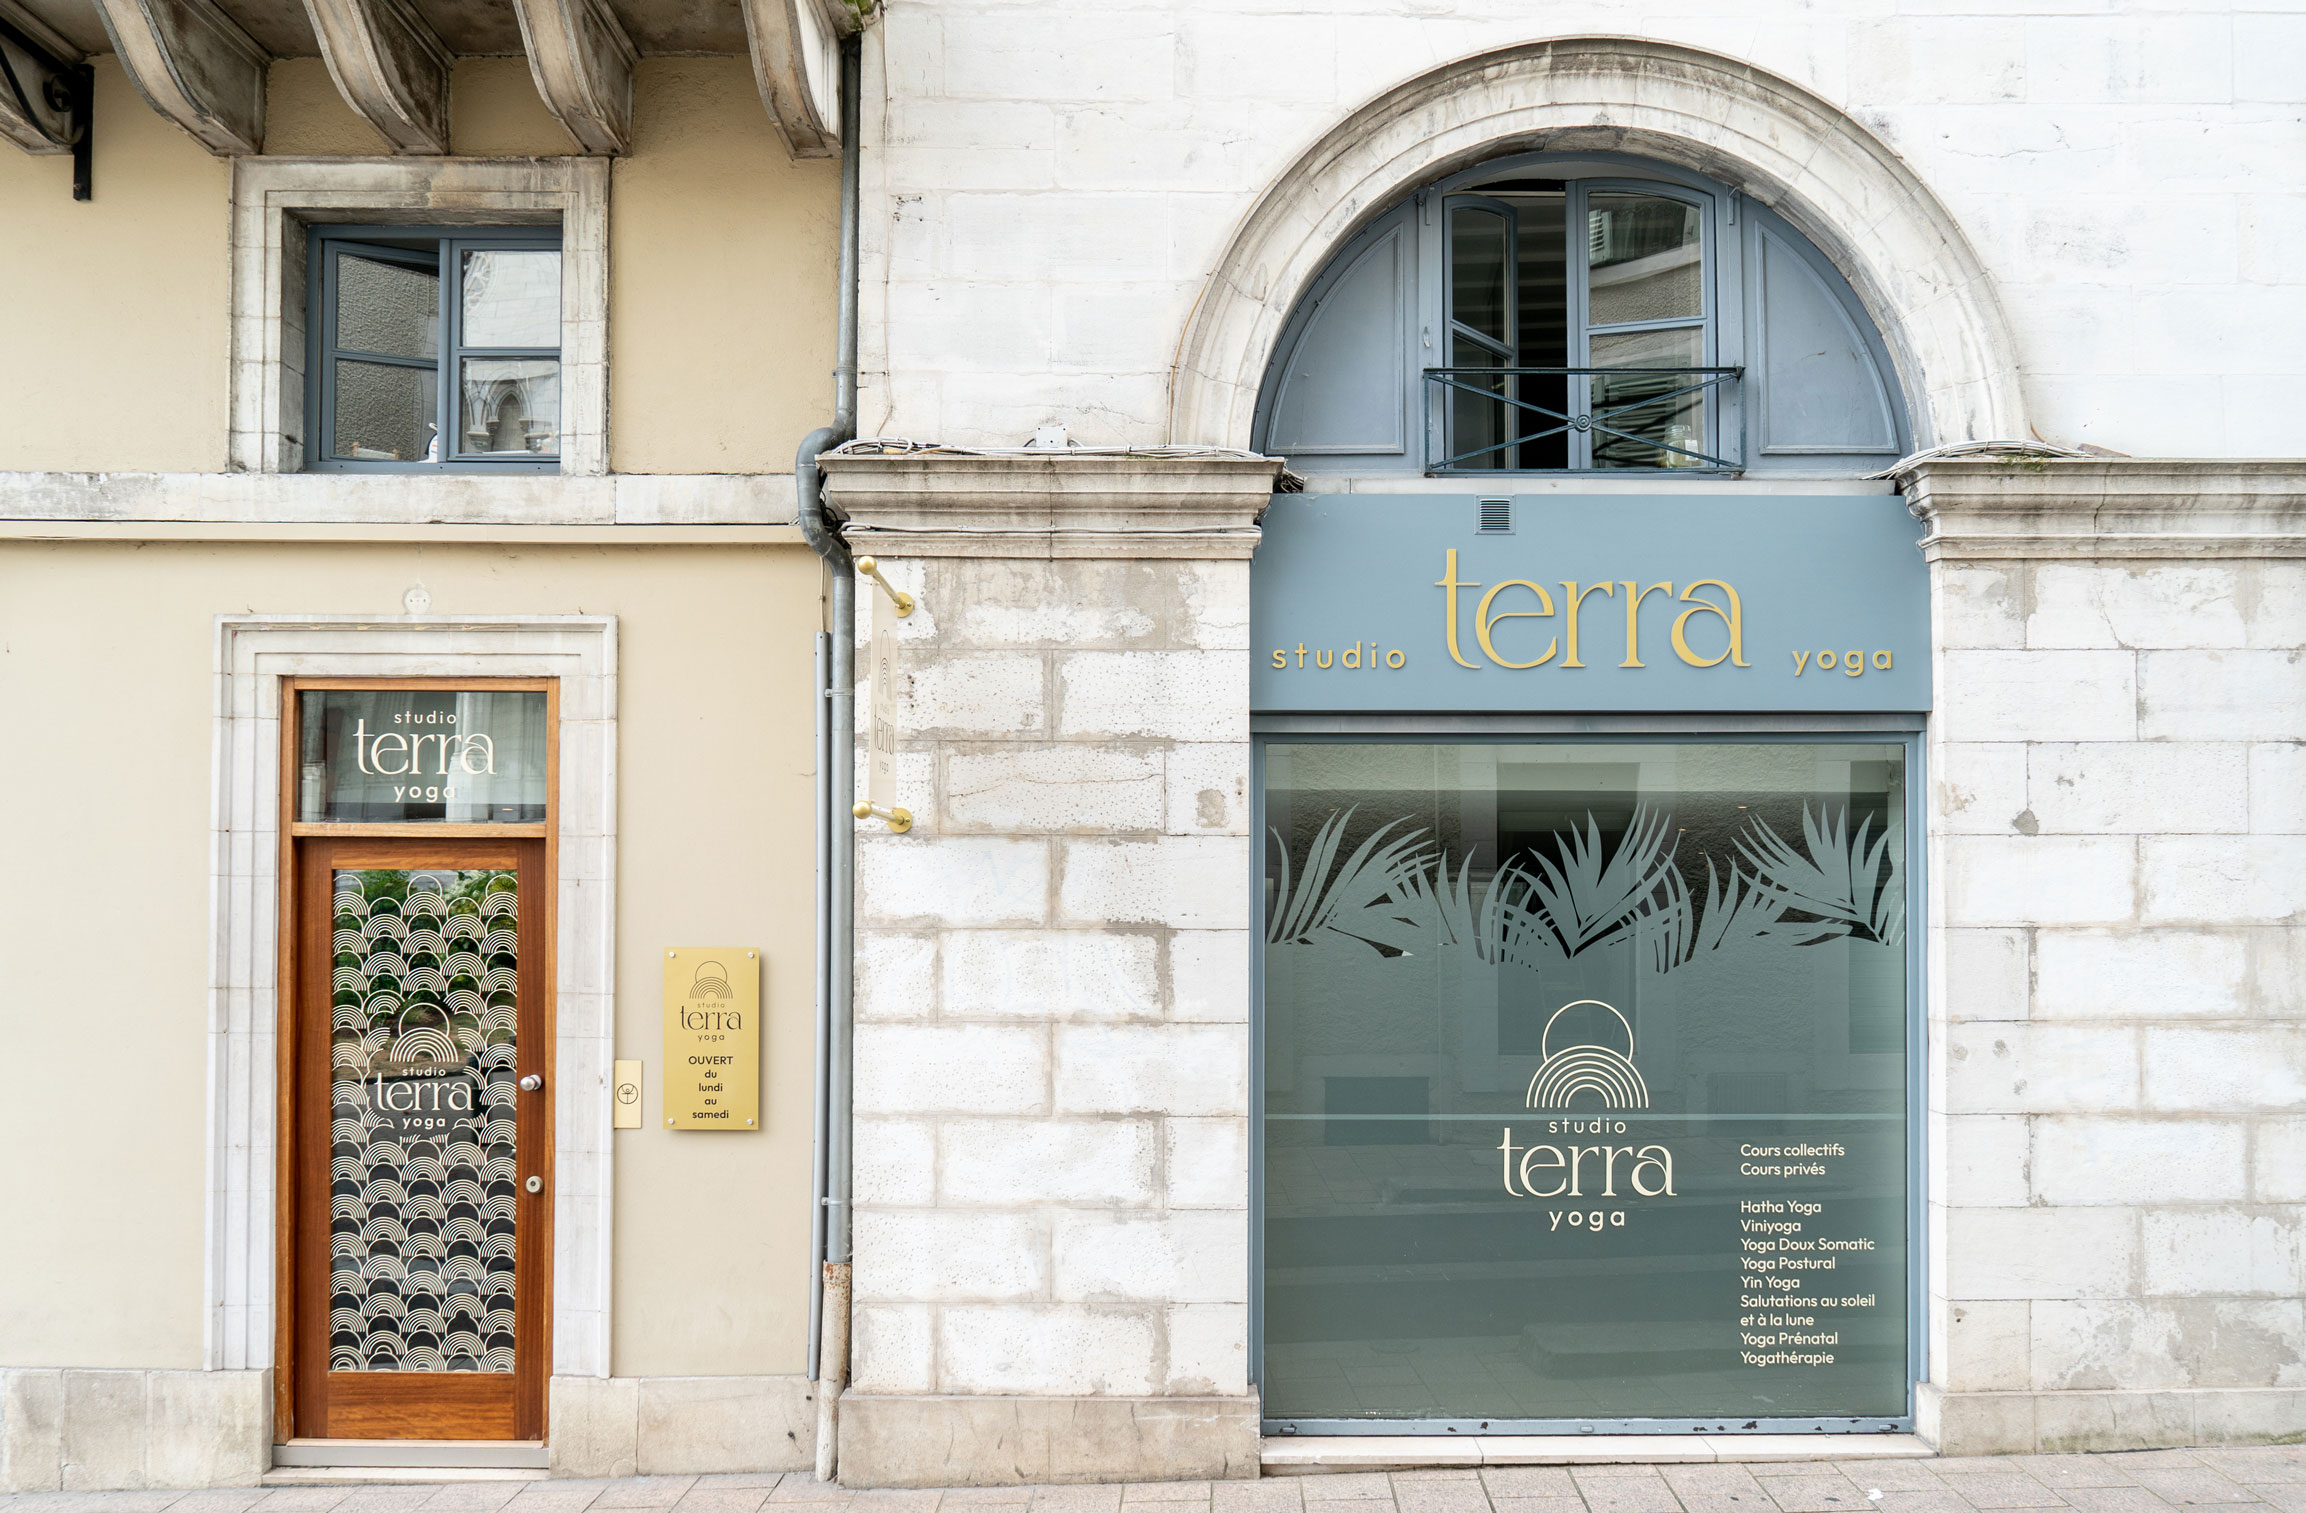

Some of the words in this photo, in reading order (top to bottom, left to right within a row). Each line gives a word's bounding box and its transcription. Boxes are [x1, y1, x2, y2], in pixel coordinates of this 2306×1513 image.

[1271, 641, 1407, 670] studio
[1434, 548, 1751, 670] terra
[1791, 648, 1893, 677] yoga
[394, 711, 457, 724] studio
[353, 718, 497, 775] terra
[393, 786, 456, 803] yoga
[680, 1006, 742, 1030] terra
[698, 1034, 724, 1042] yoga
[688, 1056, 733, 1065] OUVERT
[402, 1066, 446, 1077] studio
[704, 1069, 717, 1078] du
[375, 1072, 474, 1111] terra
[698, 1083, 723, 1092] lundi
[692, 1110, 729, 1119] samedi
[402, 1117, 446, 1130] yoga
[1548, 1117, 1627, 1134] studio
[1740, 1143, 1781, 1157] Cours
[1784, 1143, 1845, 1157] collectifs
[1497, 1127, 1677, 1197] terra
[1740, 1163, 1781, 1176] Cours
[1784, 1162, 1826, 1178] privés
[1740, 1200, 1784, 1214] Hatha
[1787, 1200, 1822, 1216] Yoga
[1548, 1210, 1625, 1232] yoga
[1740, 1219, 1801, 1235] Viniyoga
[1740, 1238, 1776, 1254] Yoga
[1779, 1238, 1815, 1251] Doux
[1818, 1237, 1875, 1251] Somatic
[1740, 1257, 1776, 1273] Yoga
[1779, 1256, 1836, 1270] Postural
[1740, 1276, 1762, 1289] Yin
[1765, 1275, 1800, 1291] Yoga
[1740, 1294, 1818, 1308] Salutations
[1820, 1297, 1839, 1308] au
[1840, 1293, 1875, 1308] soleil
[1740, 1314, 1755, 1327] et
[1758, 1312, 1767, 1327] à
[1769, 1312, 1783, 1327] la
[1785, 1312, 1815, 1327] lune
[1740, 1332, 1776, 1348] Yoga
[1779, 1331, 1838, 1346] Prénatal
[1740, 1350, 1834, 1367] Yogathérapie
